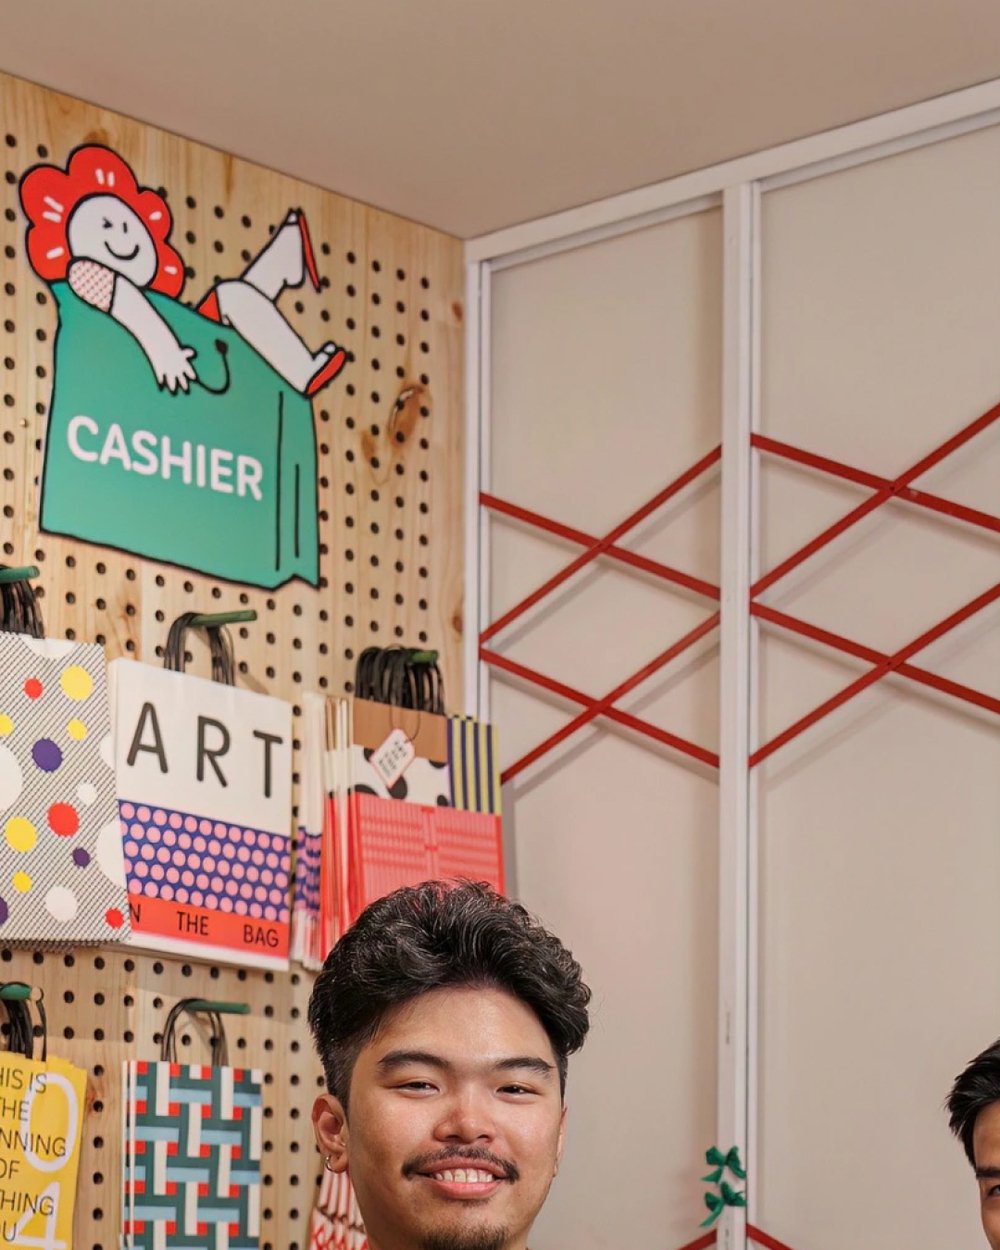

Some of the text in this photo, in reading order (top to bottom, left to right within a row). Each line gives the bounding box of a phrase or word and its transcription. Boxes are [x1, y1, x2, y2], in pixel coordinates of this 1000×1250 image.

[67, 415, 263, 501] CASHIER
[126, 701, 284, 799] ART
[177, 911, 210, 936] THE
[243, 924, 280, 948] BAG
[29, 1072, 48, 1095] IS
[0, 1097, 29, 1122] HE
[0, 1189, 54, 1216] HING
[0, 1220, 17, 1242] U
